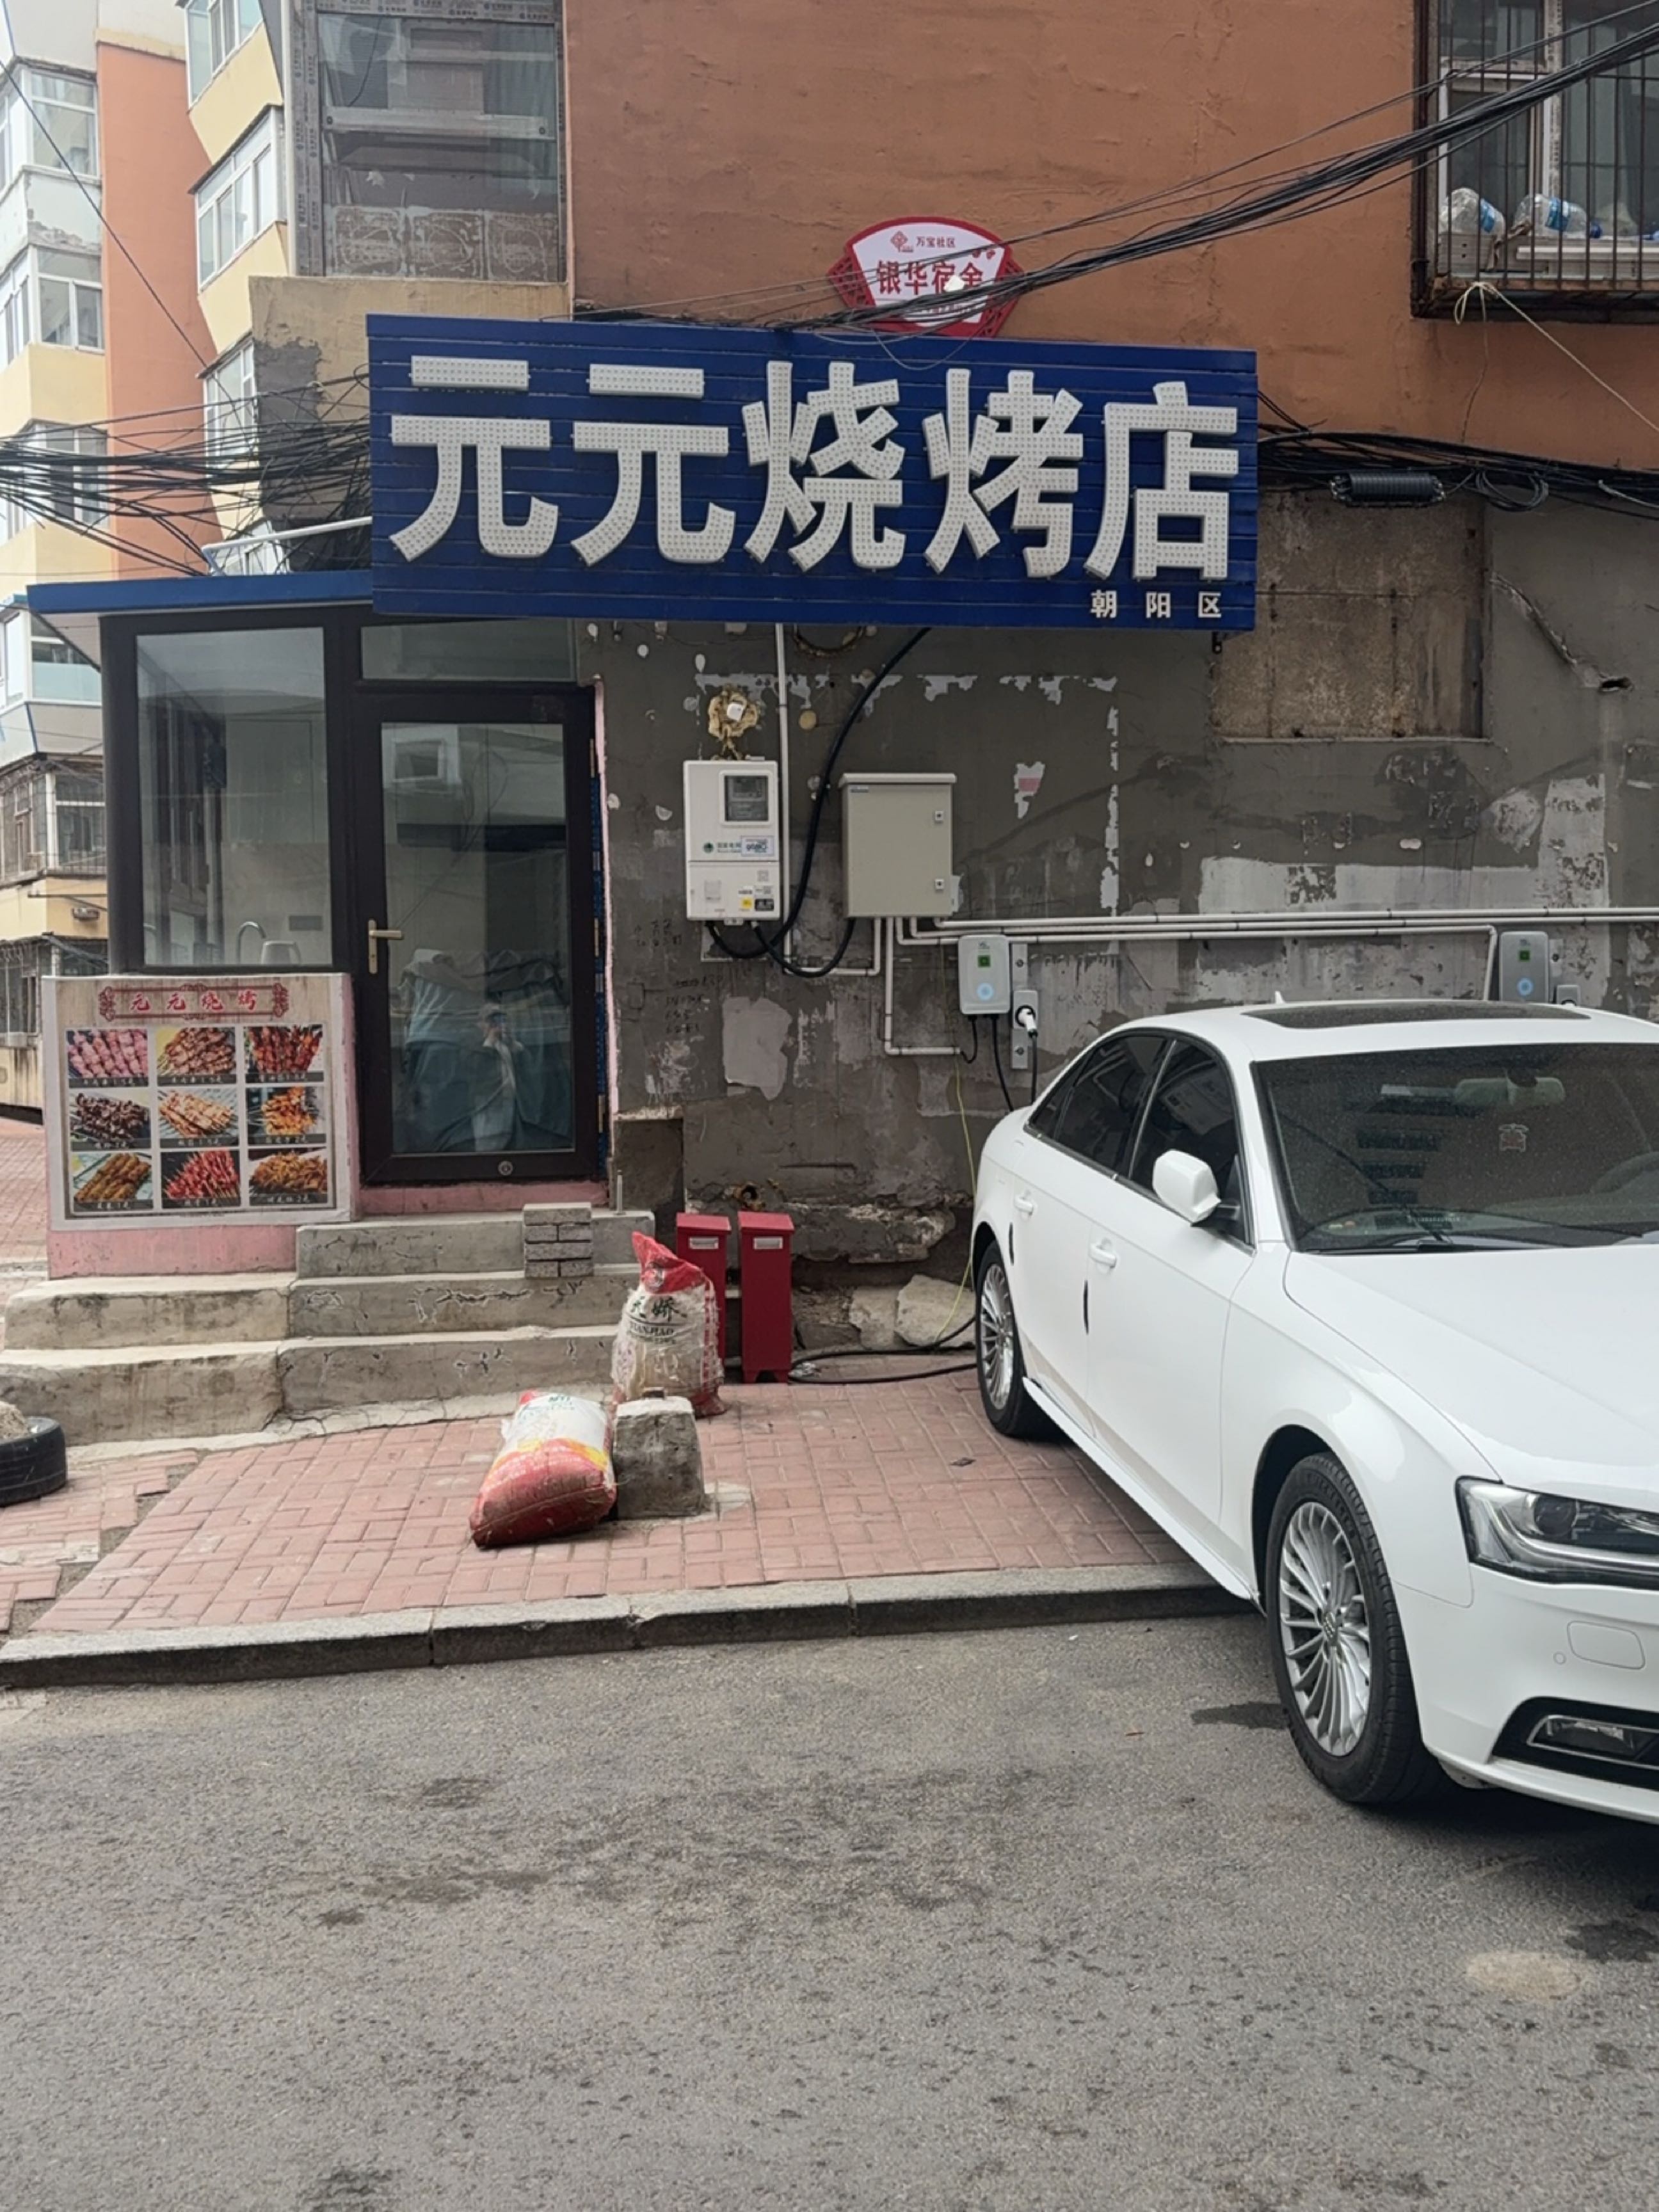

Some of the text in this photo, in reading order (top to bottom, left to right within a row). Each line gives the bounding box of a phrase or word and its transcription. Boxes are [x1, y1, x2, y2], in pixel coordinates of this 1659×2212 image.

[916, 236, 956, 248] 万宝社区
[389, 355, 1240, 581] 元元烧烤店
[1090, 589, 1222, 619] 朝阳区
[130, 990, 258, 1011] 元元烧烤
